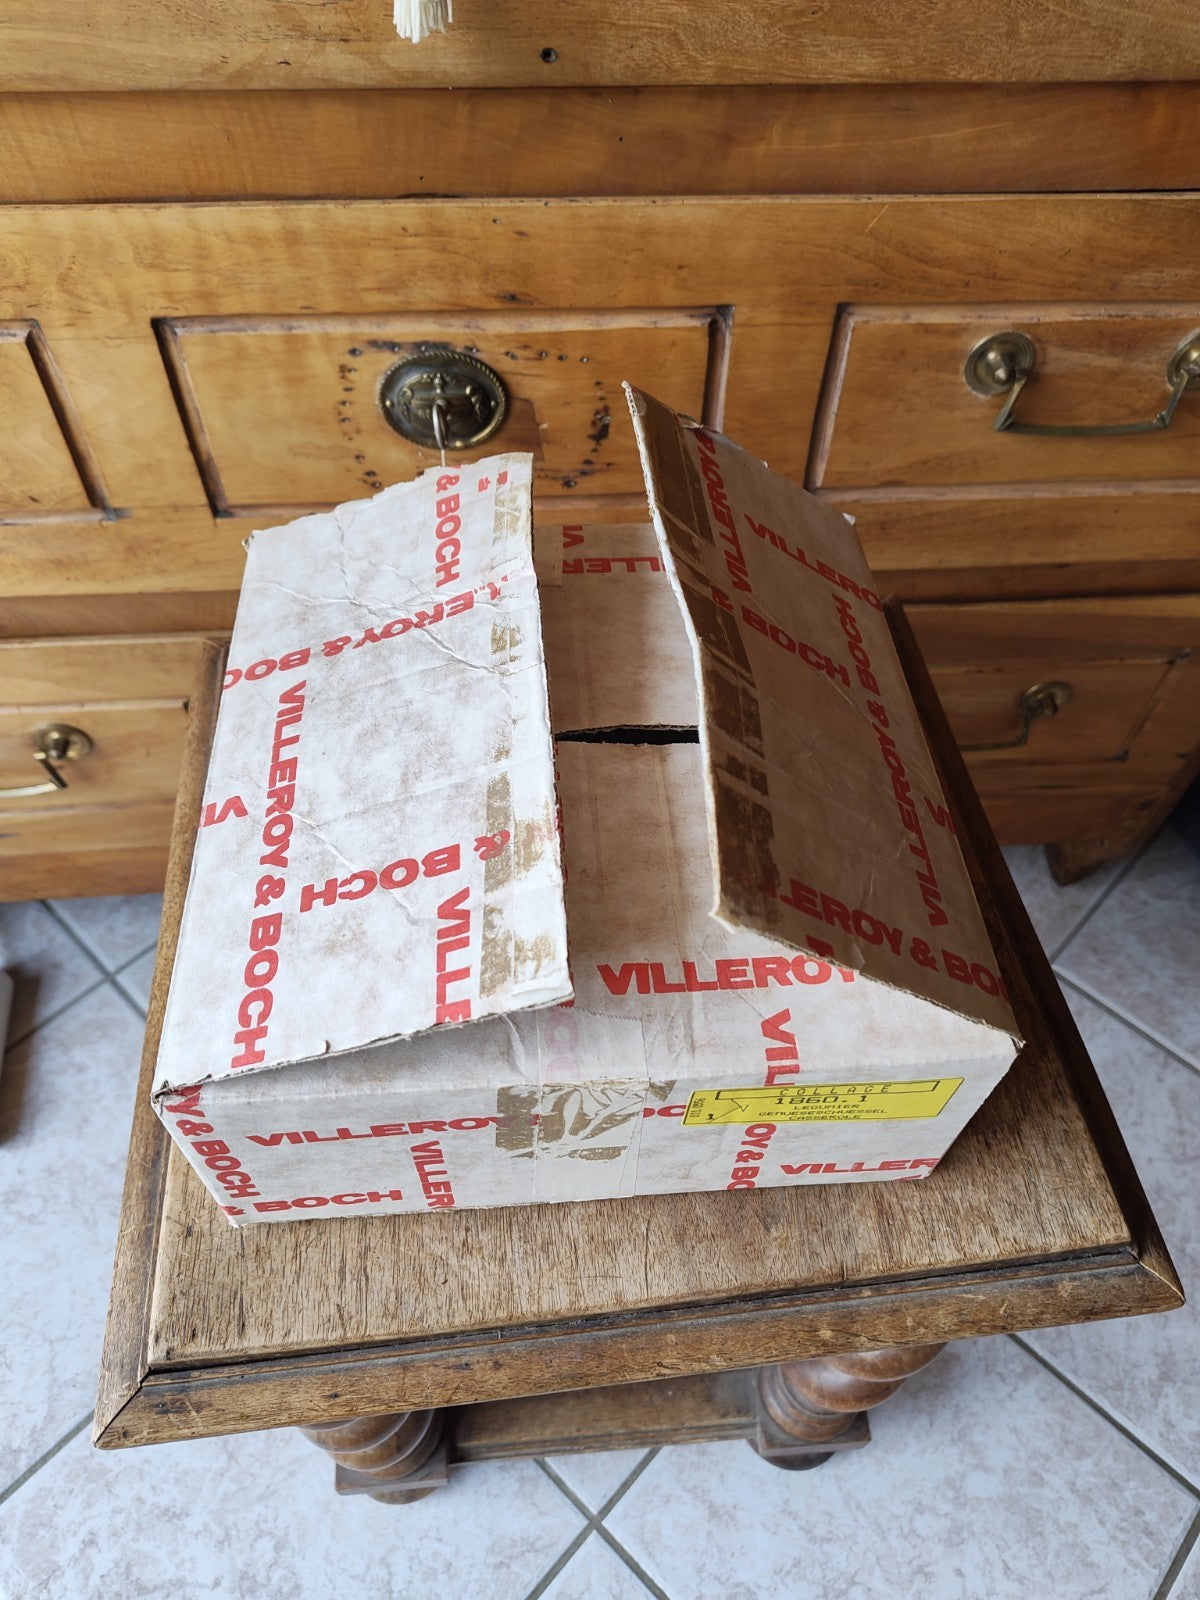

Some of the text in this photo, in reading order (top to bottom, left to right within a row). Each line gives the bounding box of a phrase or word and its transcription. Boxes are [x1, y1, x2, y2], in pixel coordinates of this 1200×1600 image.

[435, 493, 462, 588] BOCH
[741, 605, 851, 688] BOCH
[832, 593, 881, 697] BOCH
[872, 721, 948, 926] VILLEROY
[231, 680, 306, 1068] VILLEROY & BOCH
[299, 844, 461, 913] BOCH
[910, 936, 940, 973] &
[780, 1084, 892, 1096] COLLAGE
[175, 1119, 215, 1137] &
[190, 1139, 262, 1199] BOCH
[252, 1189, 403, 1213] BOCH
